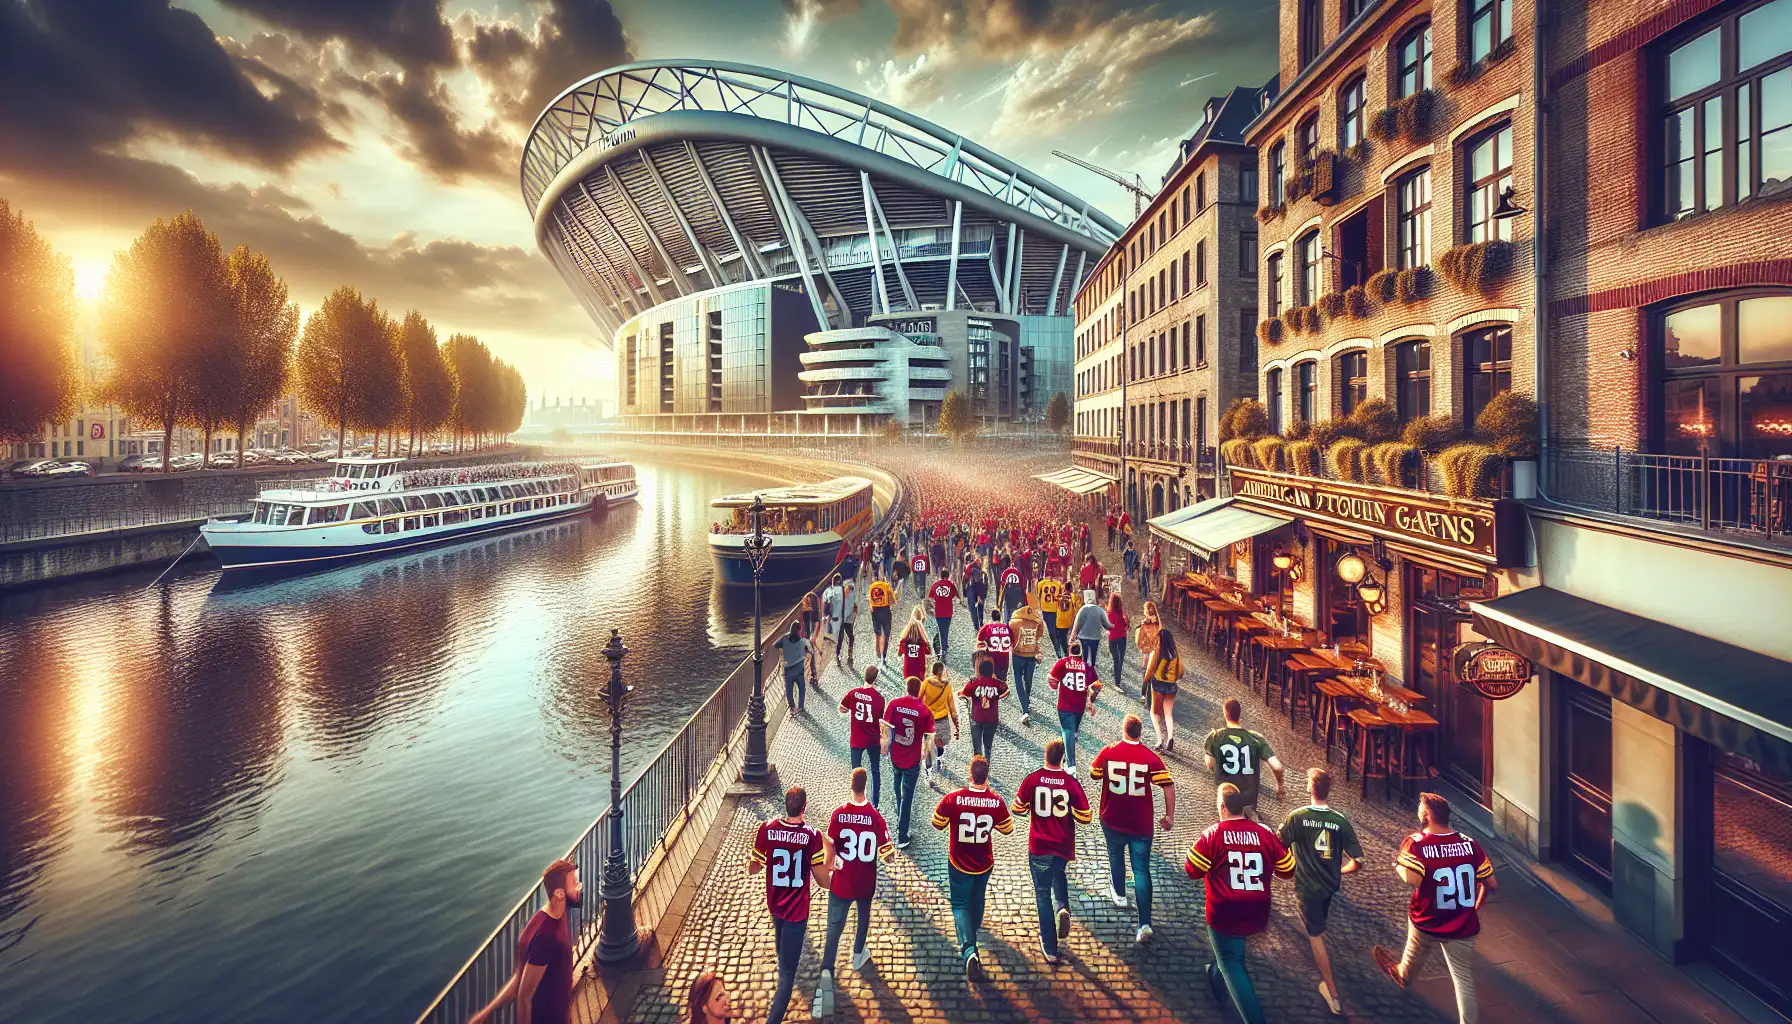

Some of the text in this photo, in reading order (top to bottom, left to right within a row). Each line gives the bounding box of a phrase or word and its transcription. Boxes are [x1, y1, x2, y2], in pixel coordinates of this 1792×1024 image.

[1219, 744, 1255, 774] 31
[1034, 786, 1069, 818] 03
[958, 812, 993, 844] 22
[1314, 829, 1332, 859] 4
[839, 828, 877, 862] 30
[772, 848, 803, 888] 21
[1228, 851, 1264, 891] 22
[1433, 864, 1475, 909] 20
